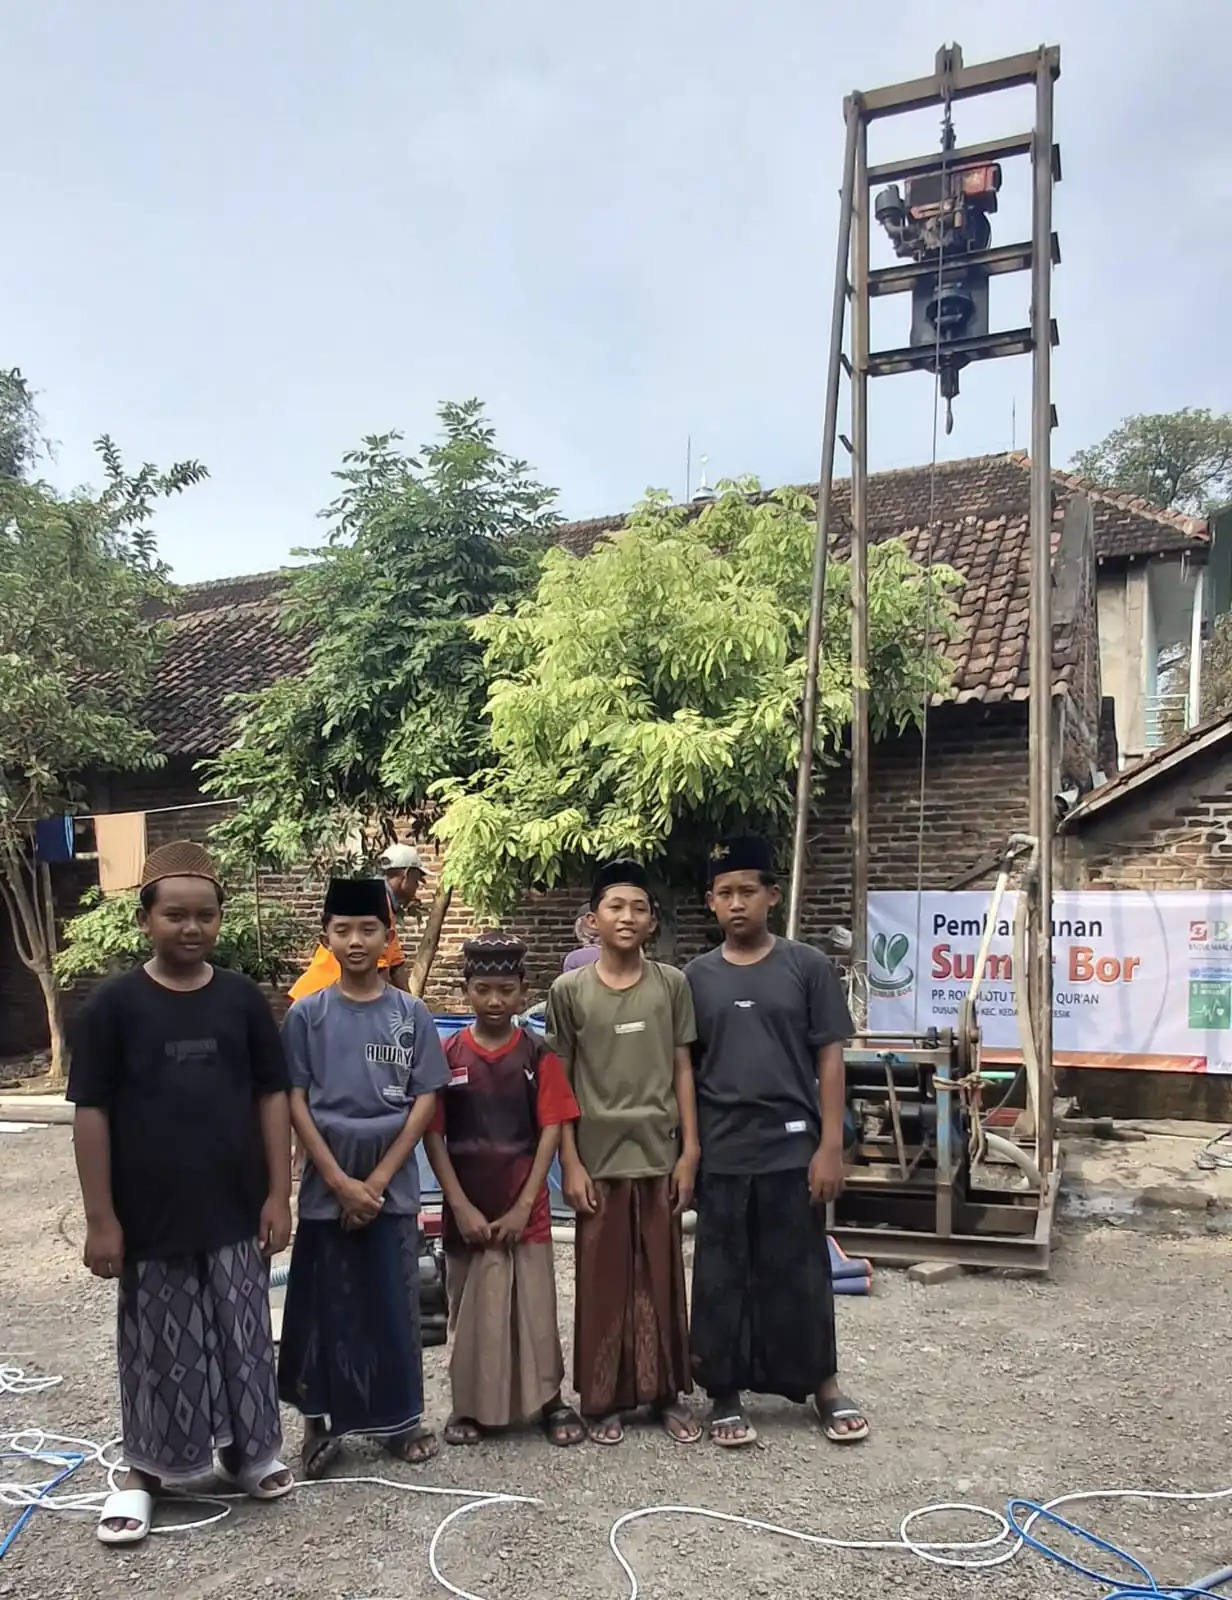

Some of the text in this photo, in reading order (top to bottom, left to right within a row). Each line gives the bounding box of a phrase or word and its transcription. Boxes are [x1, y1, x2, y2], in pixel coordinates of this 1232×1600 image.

[933, 912, 1103, 936] Pemanan
[931, 943, 1141, 982] Sum Bor
[931, 989, 946, 1000] PP.
[1055, 992, 1100, 1005] QUR'AN
